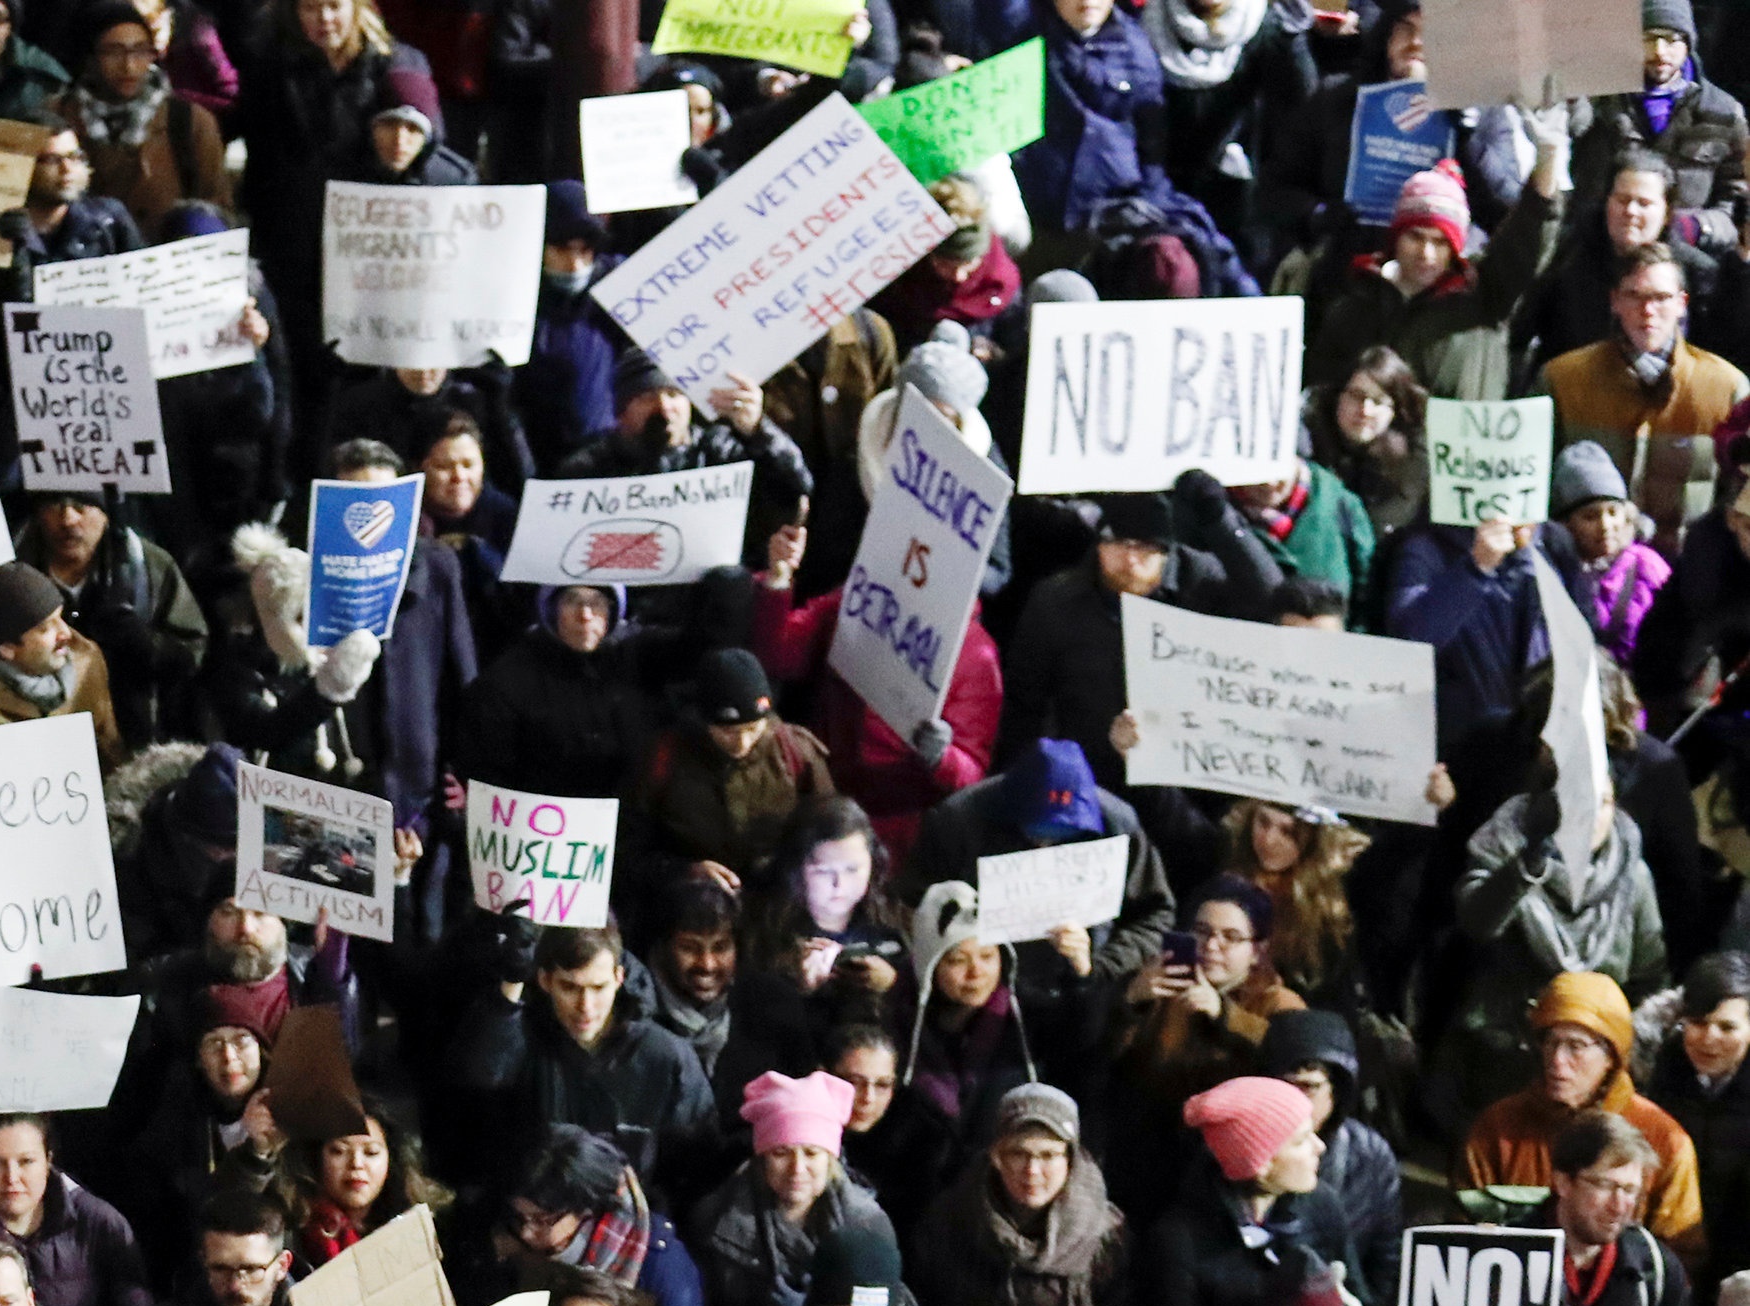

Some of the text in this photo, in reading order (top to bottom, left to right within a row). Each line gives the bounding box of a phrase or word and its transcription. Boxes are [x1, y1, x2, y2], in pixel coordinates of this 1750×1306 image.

[610, 219, 741, 327] EXTREME
[744, 116, 866, 219] VETTING
[647, 154, 901, 364] FOR PRESIDENTS
[799, 210, 952, 332] #resist
[674, 190, 922, 391] NOT REFUGEES
[13, 312, 114, 366] Trump
[20, 387, 133, 420] World's
[1049, 325, 1291, 461] NO BAN
[57, 419, 112, 445] real
[1460, 405, 1522, 442] NO
[22, 440, 156, 477] THREAT
[1433, 442, 1537, 482] Religious
[889, 428, 996, 553] SILENCE
[901, 536, 931, 589] IS
[848, 564, 947, 693] BETRAYAL
[1150, 621, 1259, 677] Because
[239, 765, 390, 829] NORMALIZE
[1299, 756, 1391, 803] AGAIN
[490, 795, 567, 837] NO
[472, 826, 610, 884] MUSLIM
[239, 868, 385, 930] ACTIVISM
[486, 870, 582, 923] BAN
